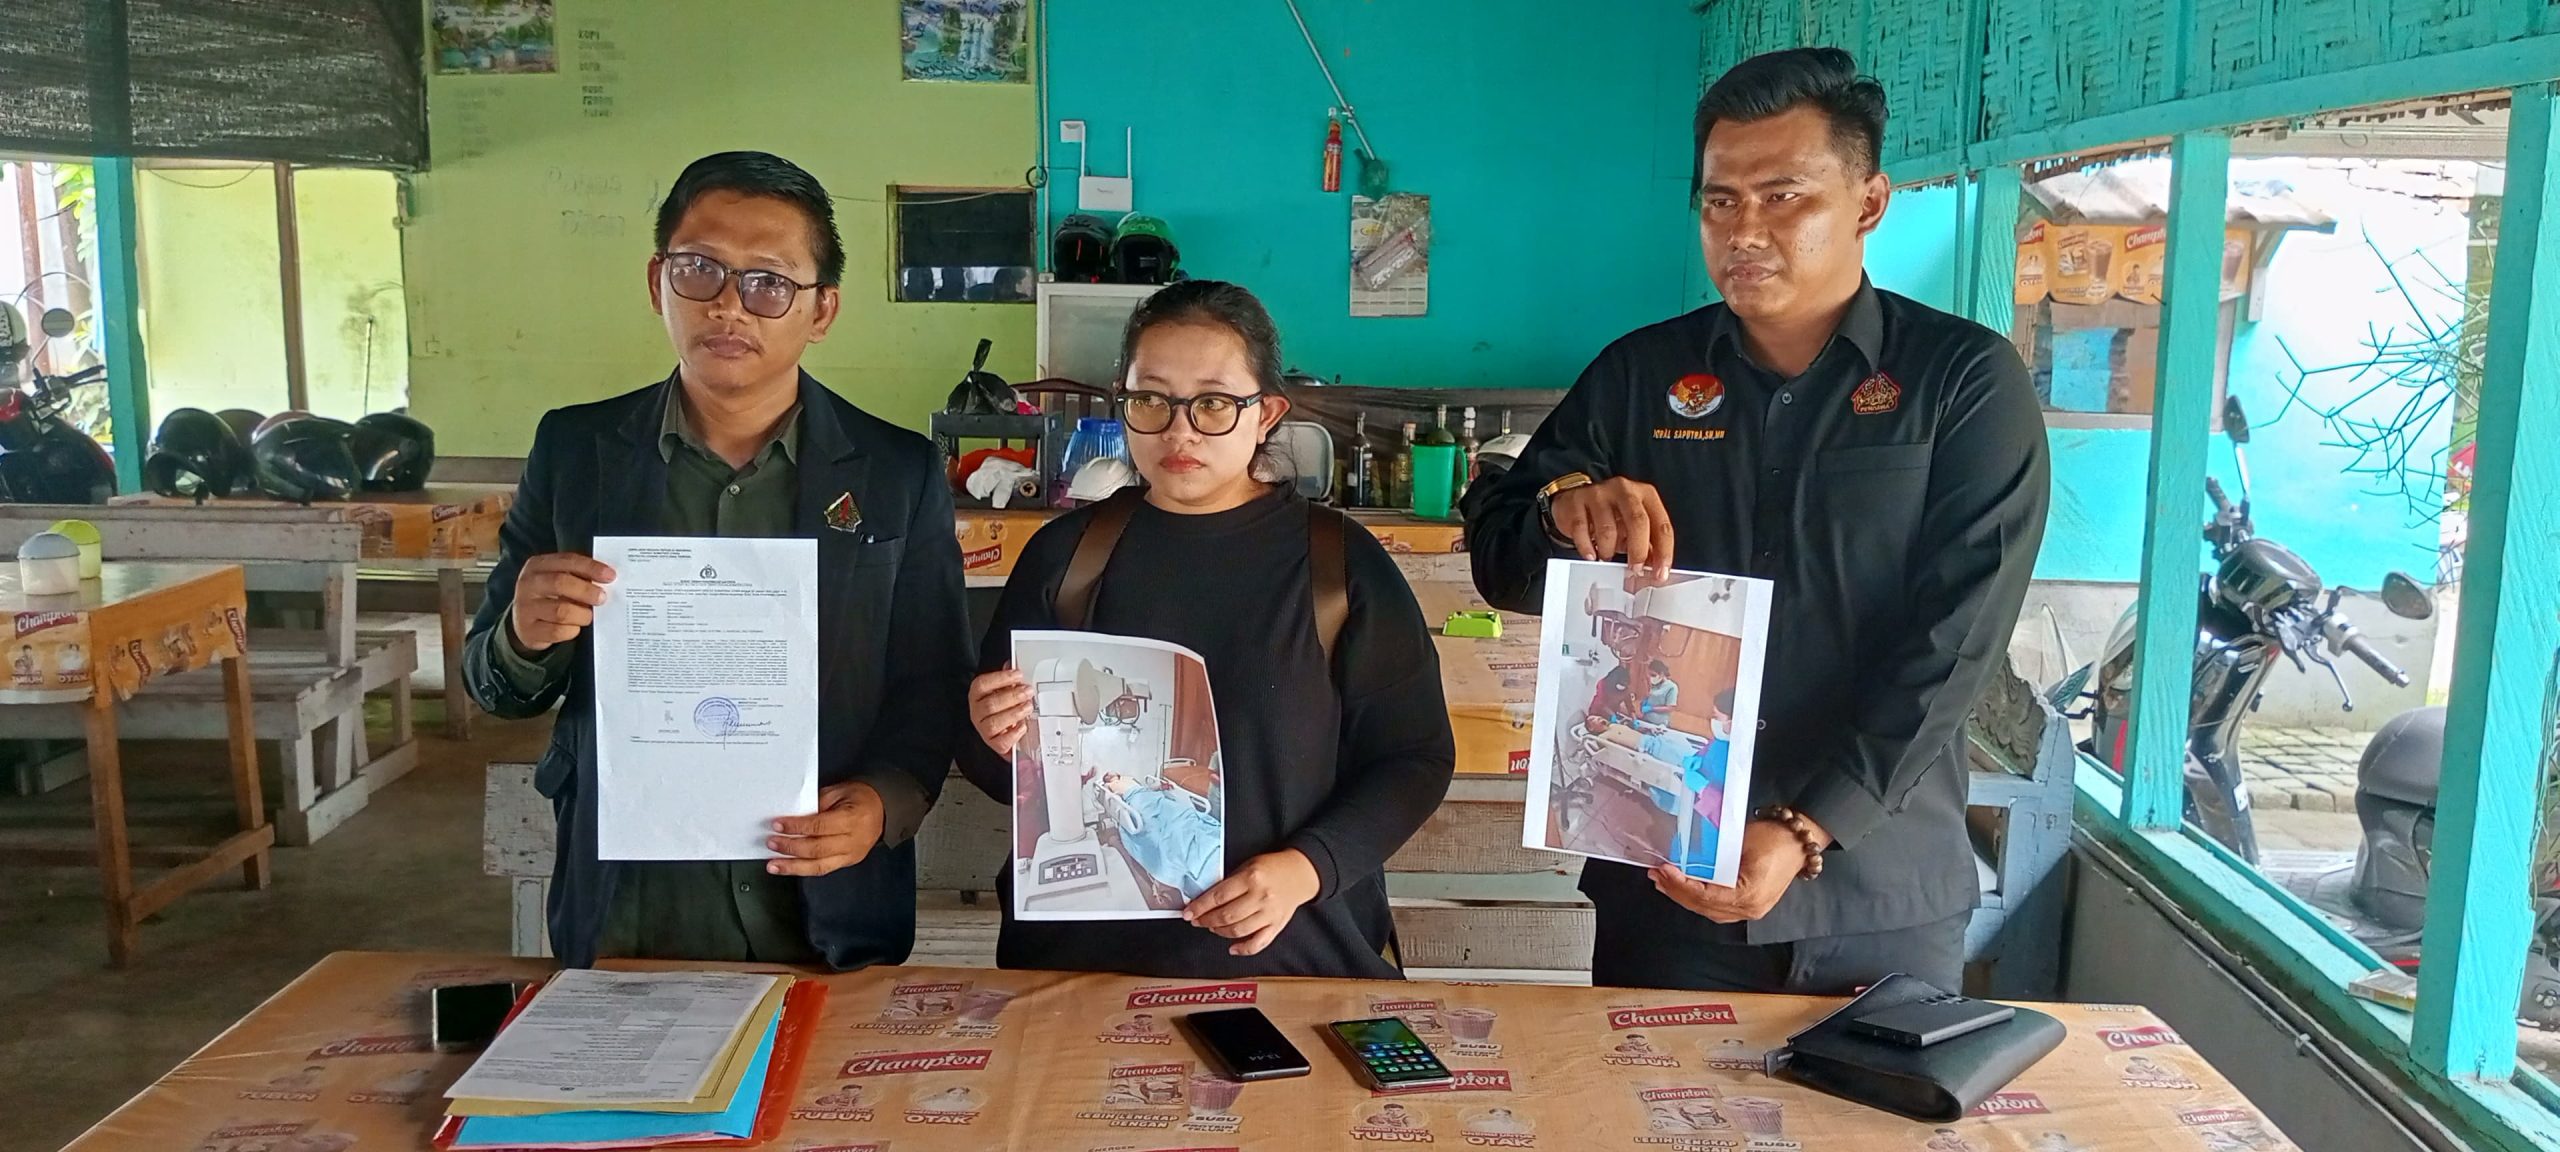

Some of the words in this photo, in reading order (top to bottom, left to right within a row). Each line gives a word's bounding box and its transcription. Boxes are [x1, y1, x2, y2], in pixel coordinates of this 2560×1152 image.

[964, 548, 1000, 568] Champi
[1133, 987, 1255, 1007] Champion
[1614, 1007, 1734, 1027] Champion
[1095, 1034, 1172, 1045] TUBUH
[847, 1052, 987, 1075] Champion
[1602, 1057, 1681, 1068] TUBUH
[1451, 1072, 1505, 1089] pion
[790, 1111, 875, 1122] TUBUH
[905, 1114, 972, 1125] OTAK
[1077, 1112, 1116, 1120] LEBIH
[1117, 1112, 1180, 1122] LENGKAP
[1109, 1120, 1169, 1129] DENGAN
[1349, 1129, 1435, 1143] TUBUH
[1633, 1136, 1673, 1144] LEBIH
[1674, 1137, 1738, 1147] LENGKAP
[1466, 1136, 1535, 1149] OTAK
